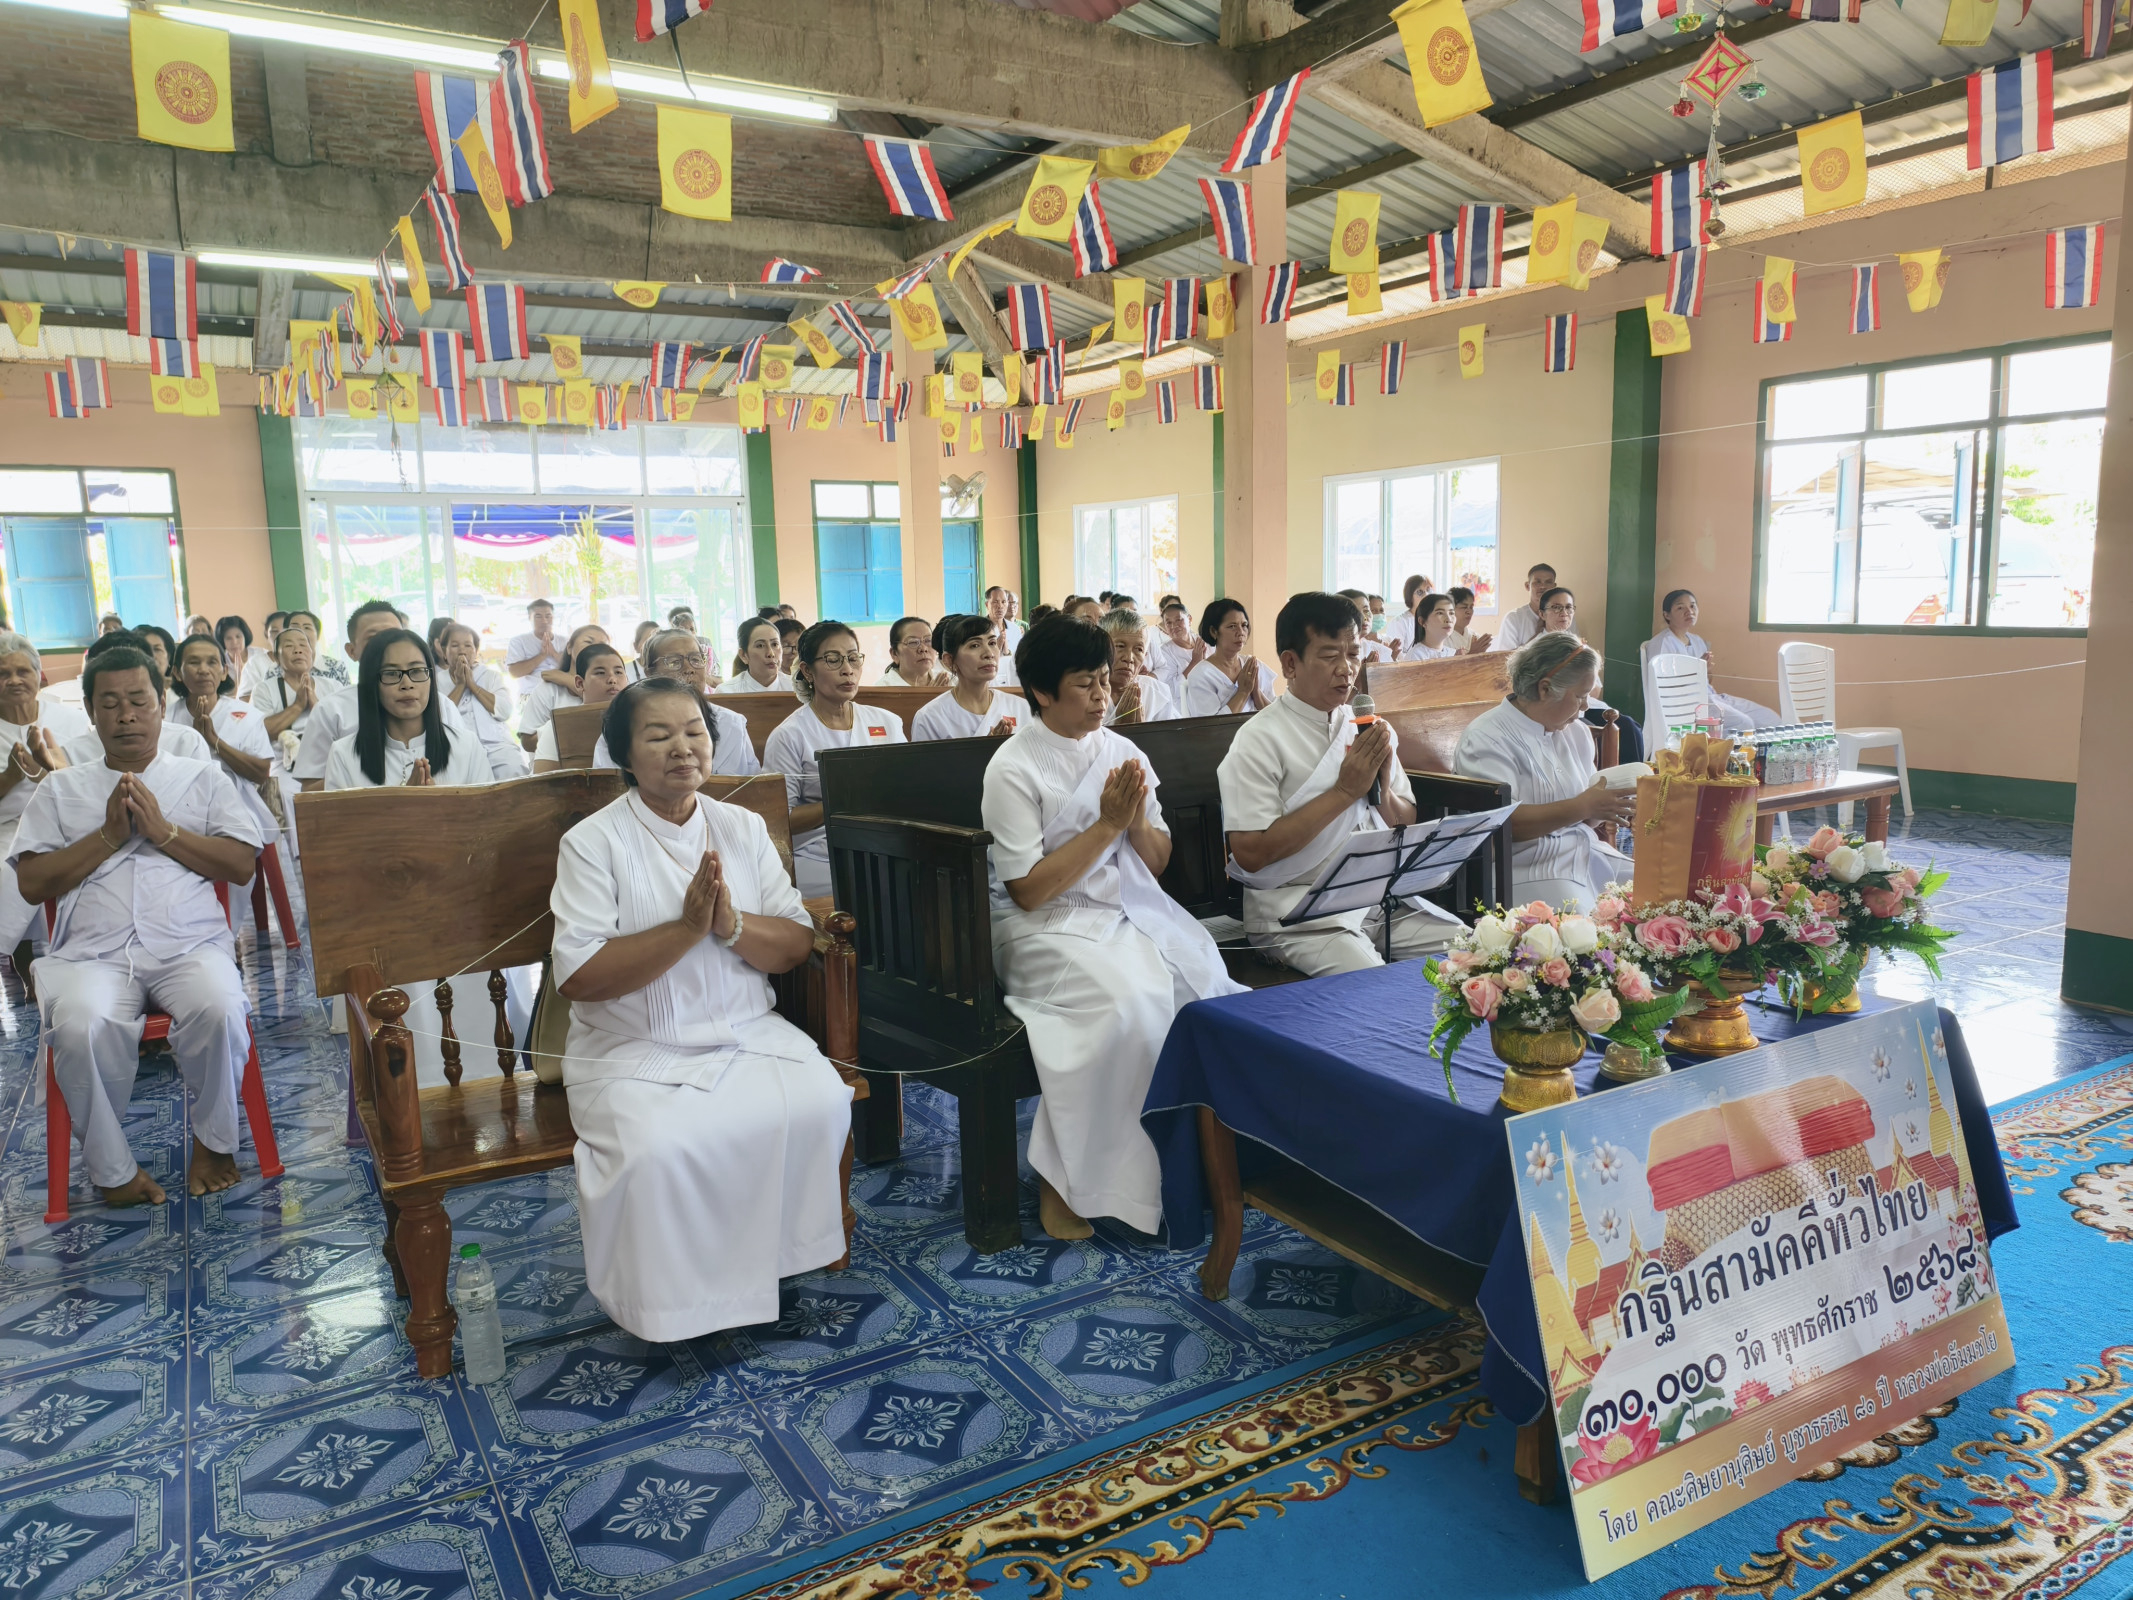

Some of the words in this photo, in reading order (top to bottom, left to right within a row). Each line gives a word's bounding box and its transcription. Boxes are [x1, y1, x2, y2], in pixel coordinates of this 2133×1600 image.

[1584, 1353, 1727, 1437] ๓๐,๐๐๐
[1735, 1328, 1766, 1371] วัด
[1771, 1294, 1879, 1364] พุทธศักราช
[1883, 1229, 1977, 1304] ๒๕๖๘
[1619, 1170, 1929, 1347] กฐินสามัคคีทั่วไทย
[1599, 1508, 1638, 1542] โดย
[1646, 1429, 1776, 1523] คณะศิษยานุศิษย์
[1781, 1405, 1849, 1462] บูชาธรรม
[1854, 1397, 1875, 1420] ๘๑
[1876, 1376, 1892, 1408] ปี
[1894, 1325, 1998, 1400] หลวงพ่อธัมมชโย
